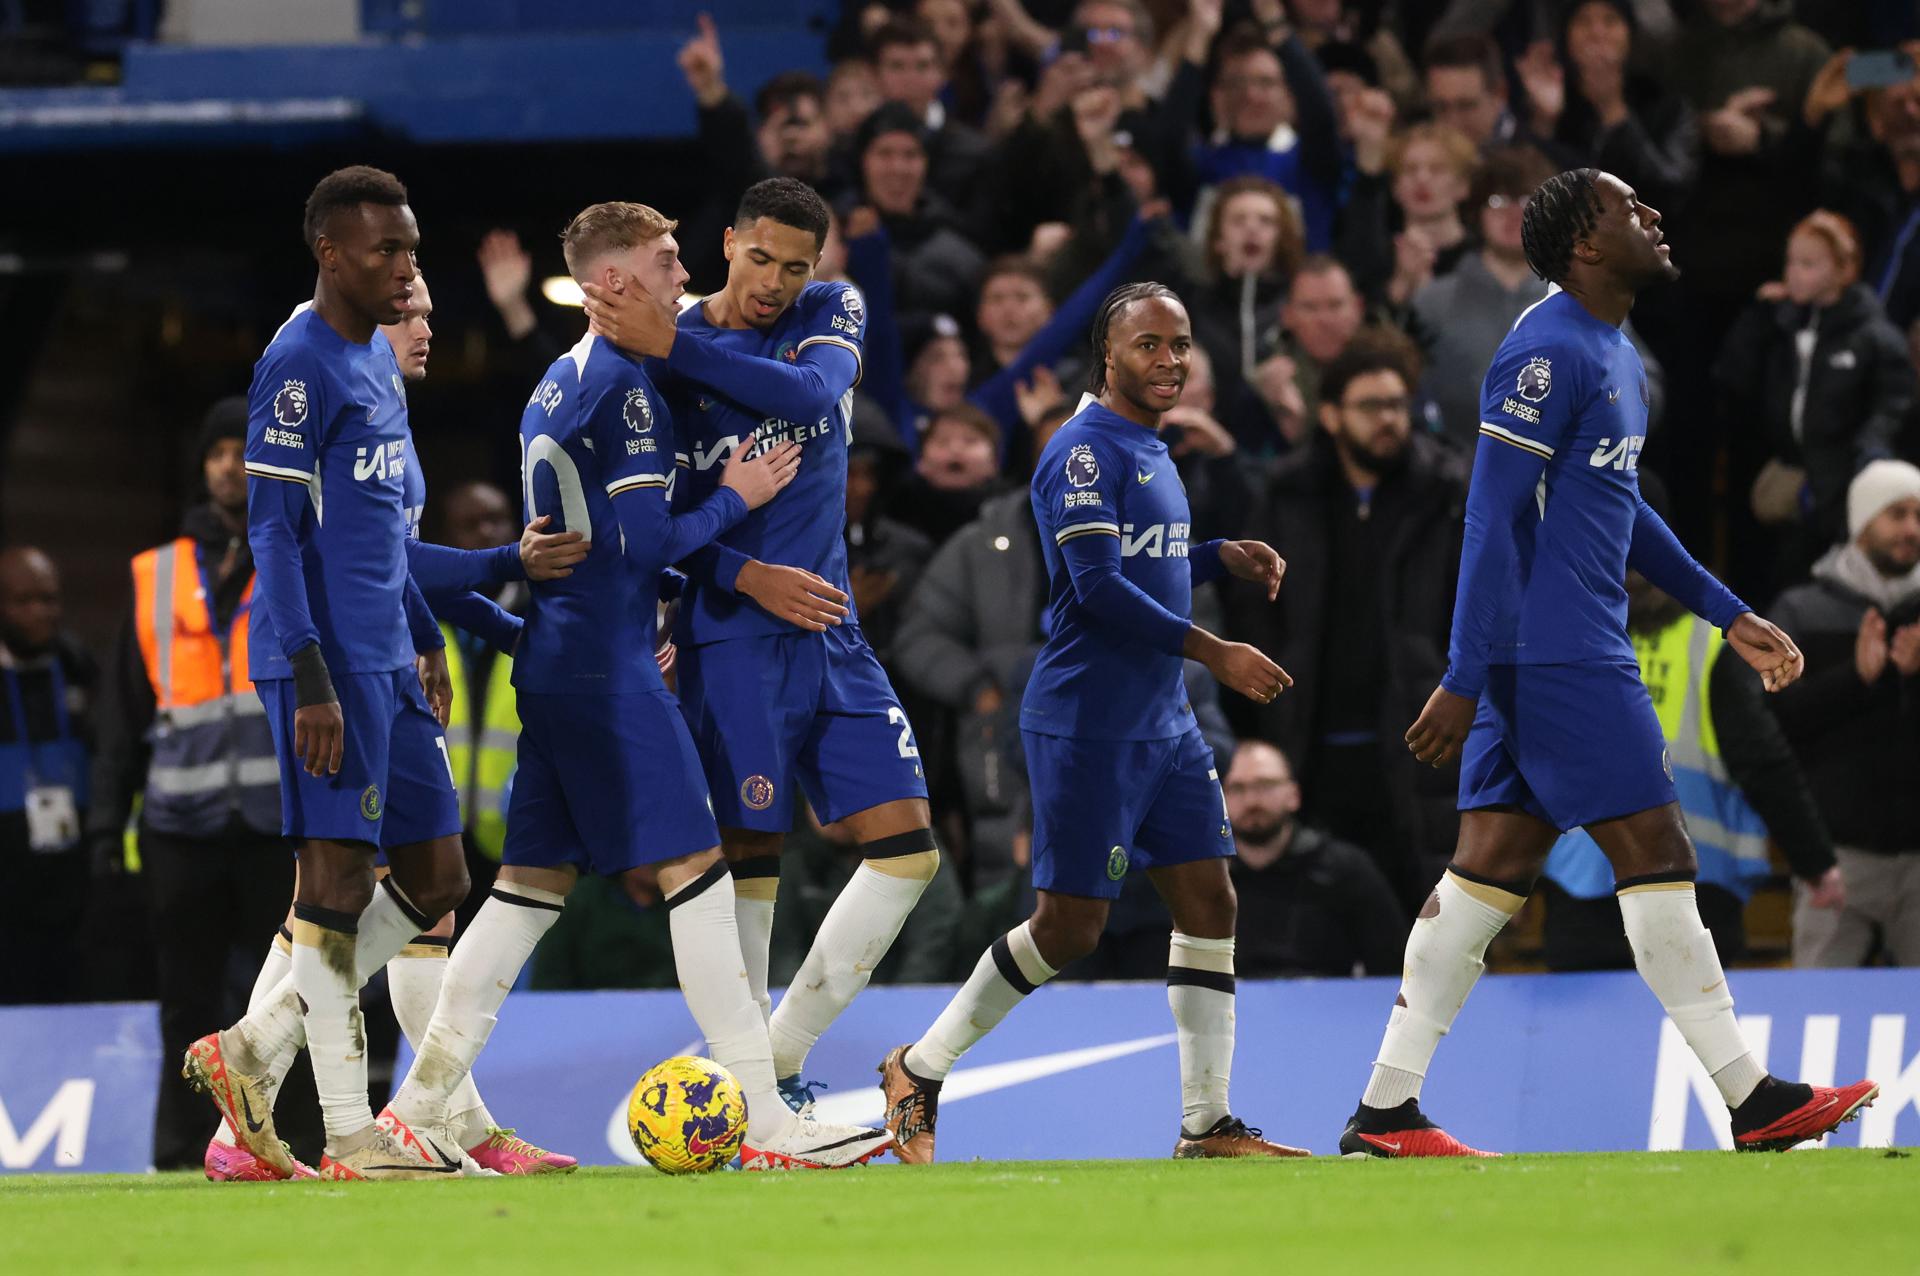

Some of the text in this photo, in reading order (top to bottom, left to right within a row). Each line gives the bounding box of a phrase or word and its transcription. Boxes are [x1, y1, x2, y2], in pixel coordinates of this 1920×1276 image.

[526, 379, 563, 418] ALMER
[1503, 397, 1540, 418] No room
[1513, 410, 1540, 425] racism
[264, 426, 302, 442] No room
[276, 438, 304, 450] racism
[626, 439, 640, 448] No
[1064, 491, 1099, 501] No room
[1076, 499, 1103, 507] racism
